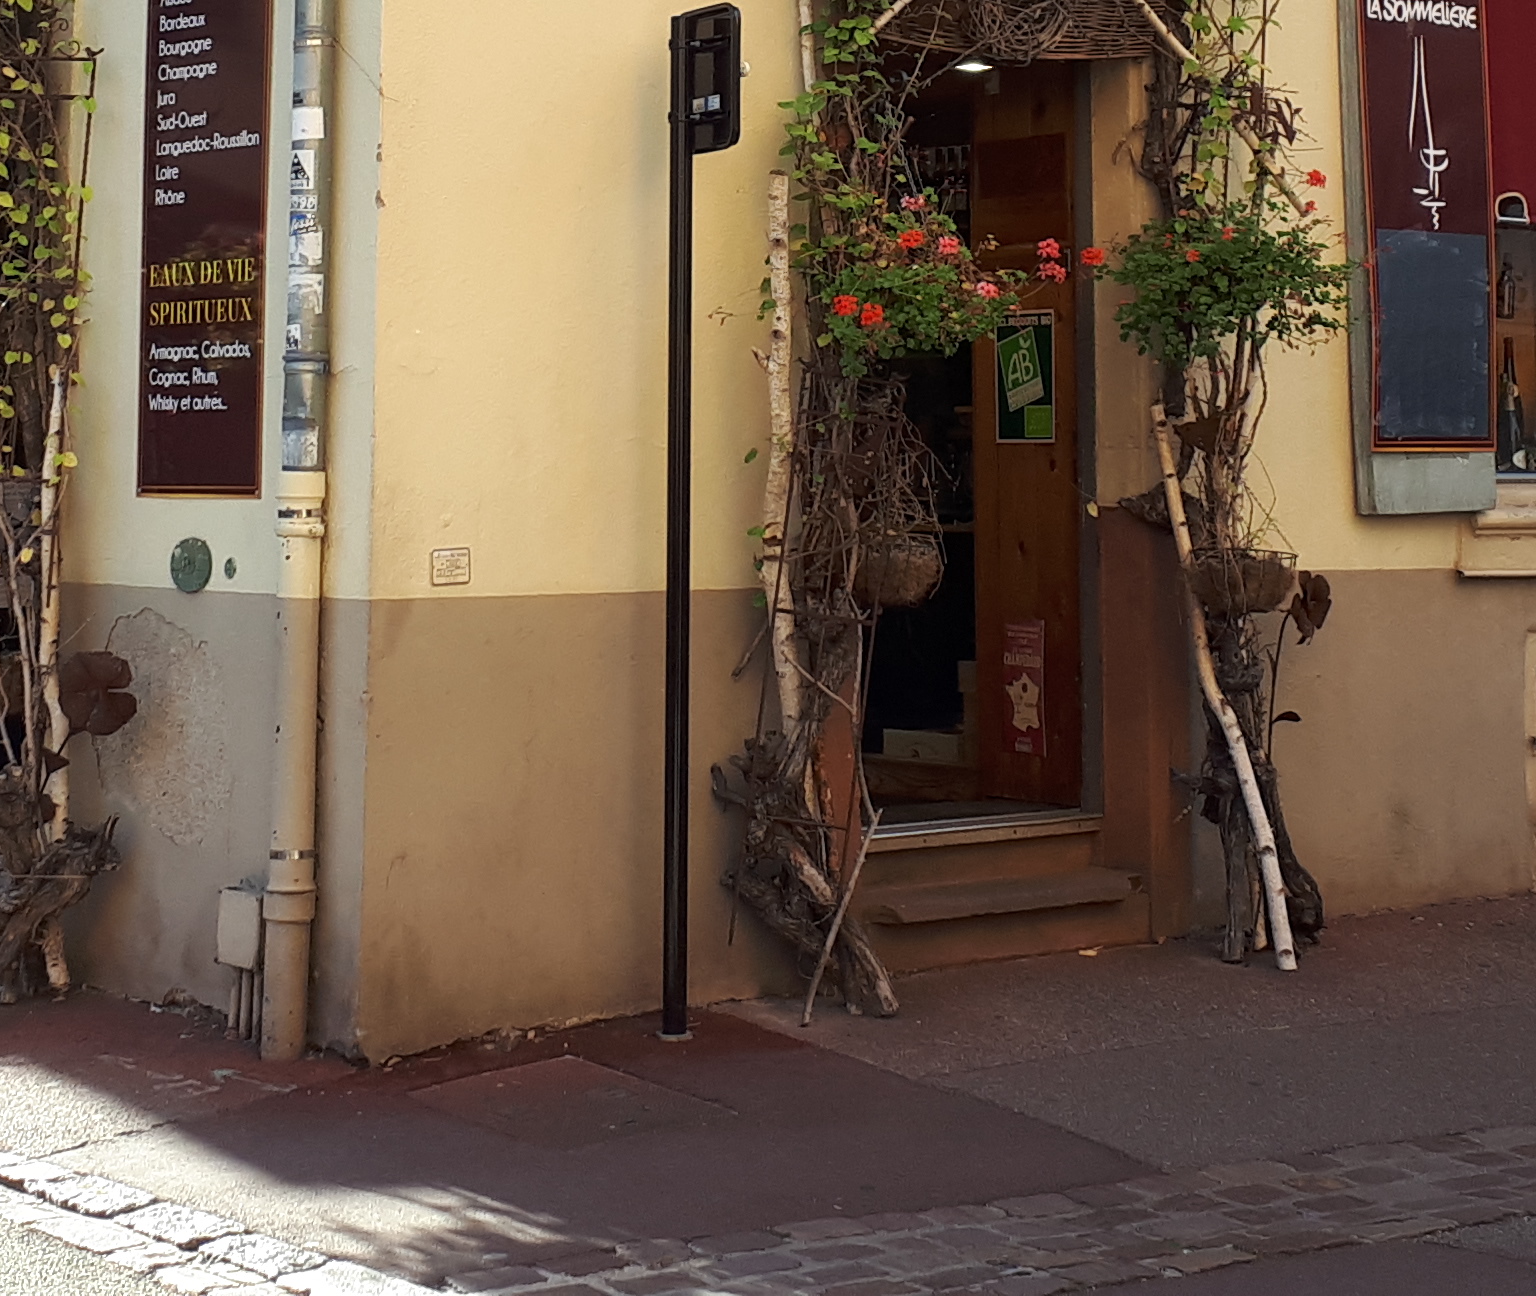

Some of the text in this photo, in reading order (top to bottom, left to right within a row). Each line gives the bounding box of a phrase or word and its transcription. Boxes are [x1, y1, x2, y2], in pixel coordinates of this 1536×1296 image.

[159, 12, 206, 32] Bordeaux
[158, 37, 212, 57] Bourgogne
[158, 62, 217, 81] Champagne
[156, 90, 176, 109] Jura
[157, 111, 207, 131] Sud-Ouest
[156, 130, 260, 157] Languedoc-Roussillon
[155, 164, 180, 181] Loire
[155, 188, 186, 206] Rhône
[149, 257, 255, 287] EAUX DE VIE
[149, 297, 253, 326] SPIRITUEUX
[149, 339, 251, 362] Armagnac, Calvados,
[149, 368, 190, 388] Cognac,
[1007, 348, 1034, 389] AB
[148, 393, 179, 414] Whisky
[180, 394, 192, 410] et
